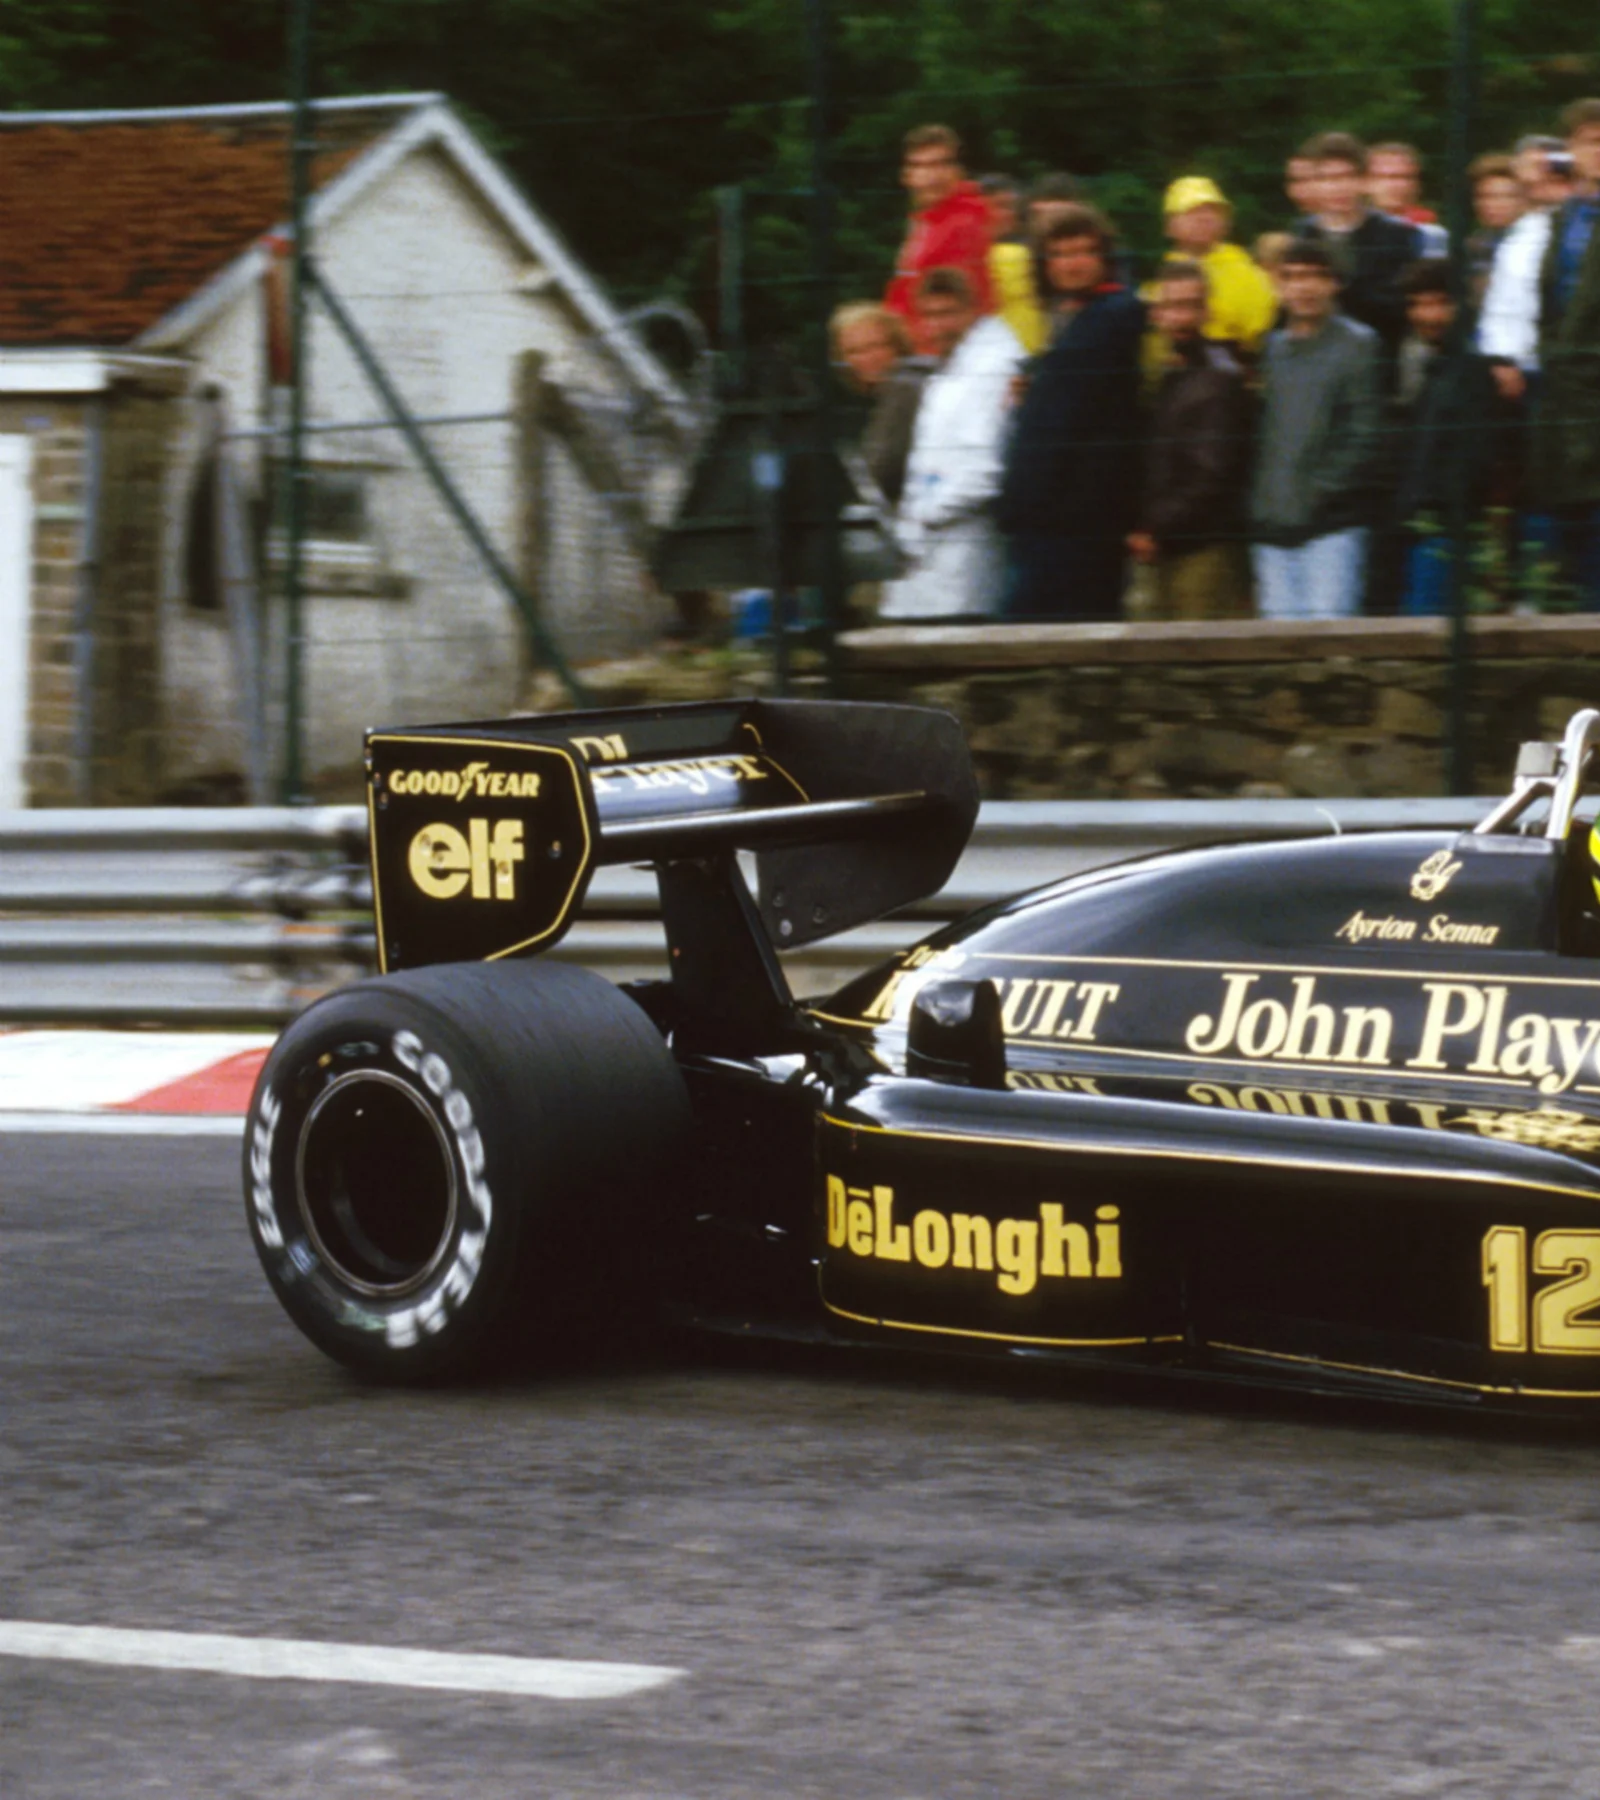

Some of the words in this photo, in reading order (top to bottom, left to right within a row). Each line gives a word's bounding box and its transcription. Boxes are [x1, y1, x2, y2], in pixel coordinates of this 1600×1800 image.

[408, 818, 524, 900] elf
[1335, 910, 1418, 943] Ayrton
[1422, 913, 1499, 945] Senna
[1186, 973, 1393, 1065] John
